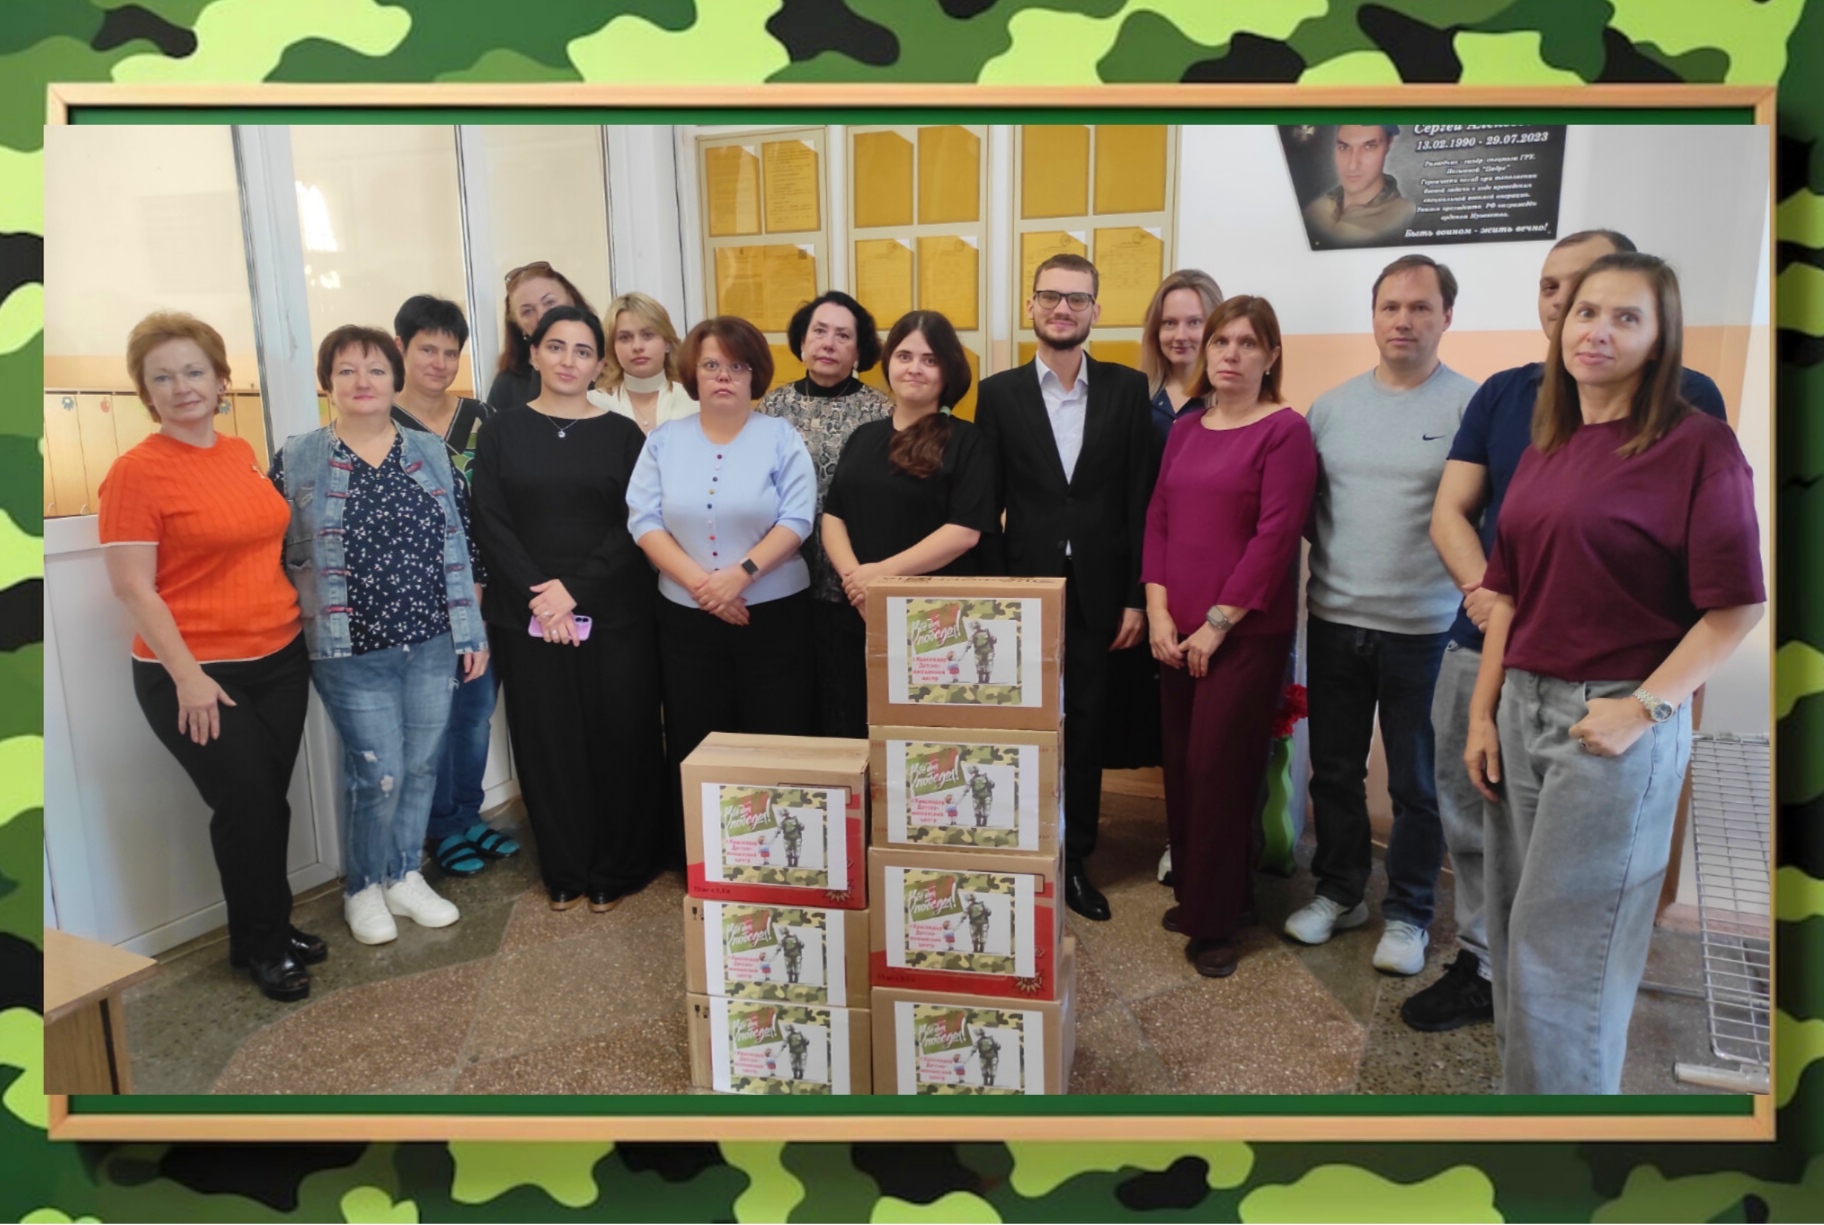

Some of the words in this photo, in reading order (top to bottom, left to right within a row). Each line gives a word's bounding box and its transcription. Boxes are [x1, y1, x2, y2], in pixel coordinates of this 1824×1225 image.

[1414, 125, 1463, 135] Сергей
[1416, 137, 1476, 151] 13.02.1990
[1485, 131, 1549, 145] 29.07.2023
[1404, 229, 1433, 238] Быть
[1435, 227, 1472, 236] воином
[1480, 225, 1513, 234] жить
[1515, 222, 1549, 232] вечно!
